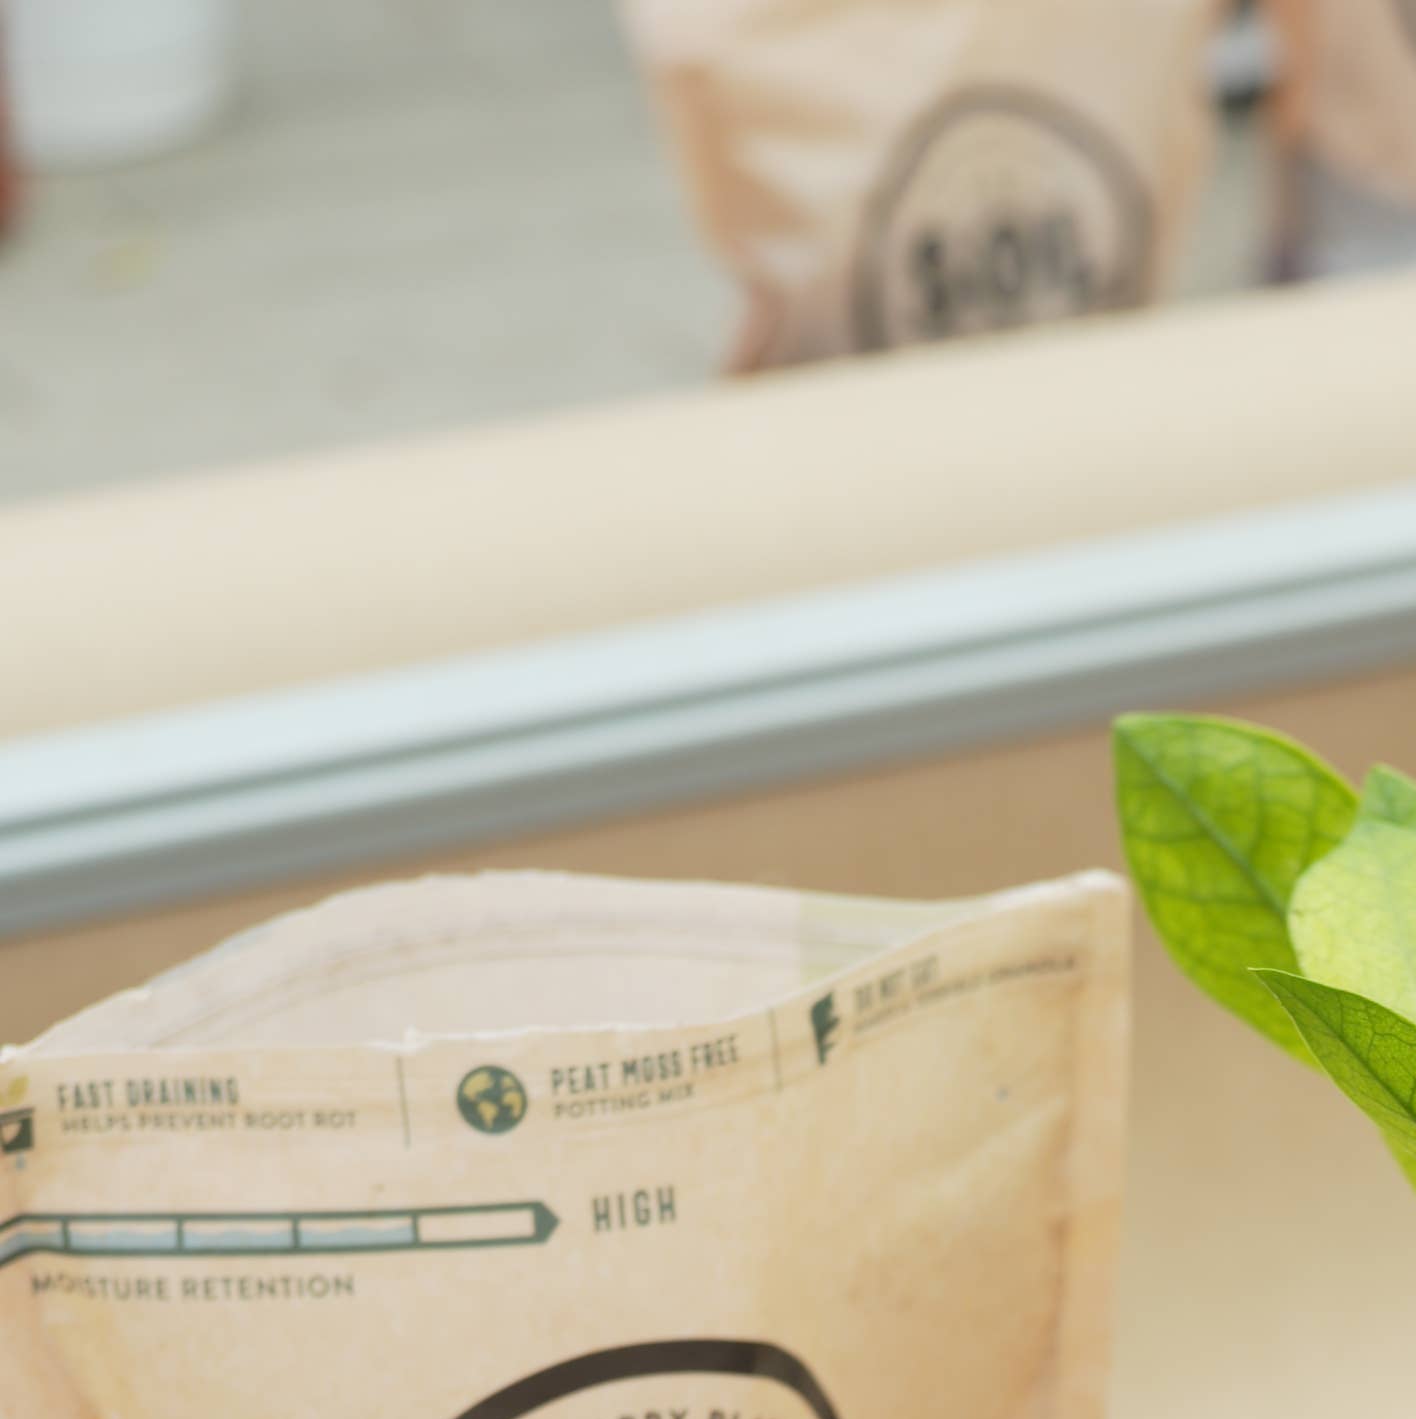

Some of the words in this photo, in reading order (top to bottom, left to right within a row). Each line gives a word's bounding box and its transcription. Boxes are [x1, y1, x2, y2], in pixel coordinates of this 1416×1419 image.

[552, 1061, 611, 1096] PEAT
[621, 1049, 684, 1086] MOSS
[689, 1033, 741, 1072] FREE
[57, 1079, 114, 1111] FAST
[126, 1076, 241, 1107] DRAINING
[555, 1090, 652, 1118] POTTING
[658, 1082, 696, 1105] MIX
[61, 1111, 132, 1135] HELPS
[138, 1109, 237, 1133] PREVENT
[244, 1109, 305, 1132] ROOT
[315, 1109, 358, 1130] ROT
[593, 1184, 678, 1233] HIGH
[31, 1272, 173, 1301] MOISTURE
[181, 1273, 357, 1301] RETENTION
